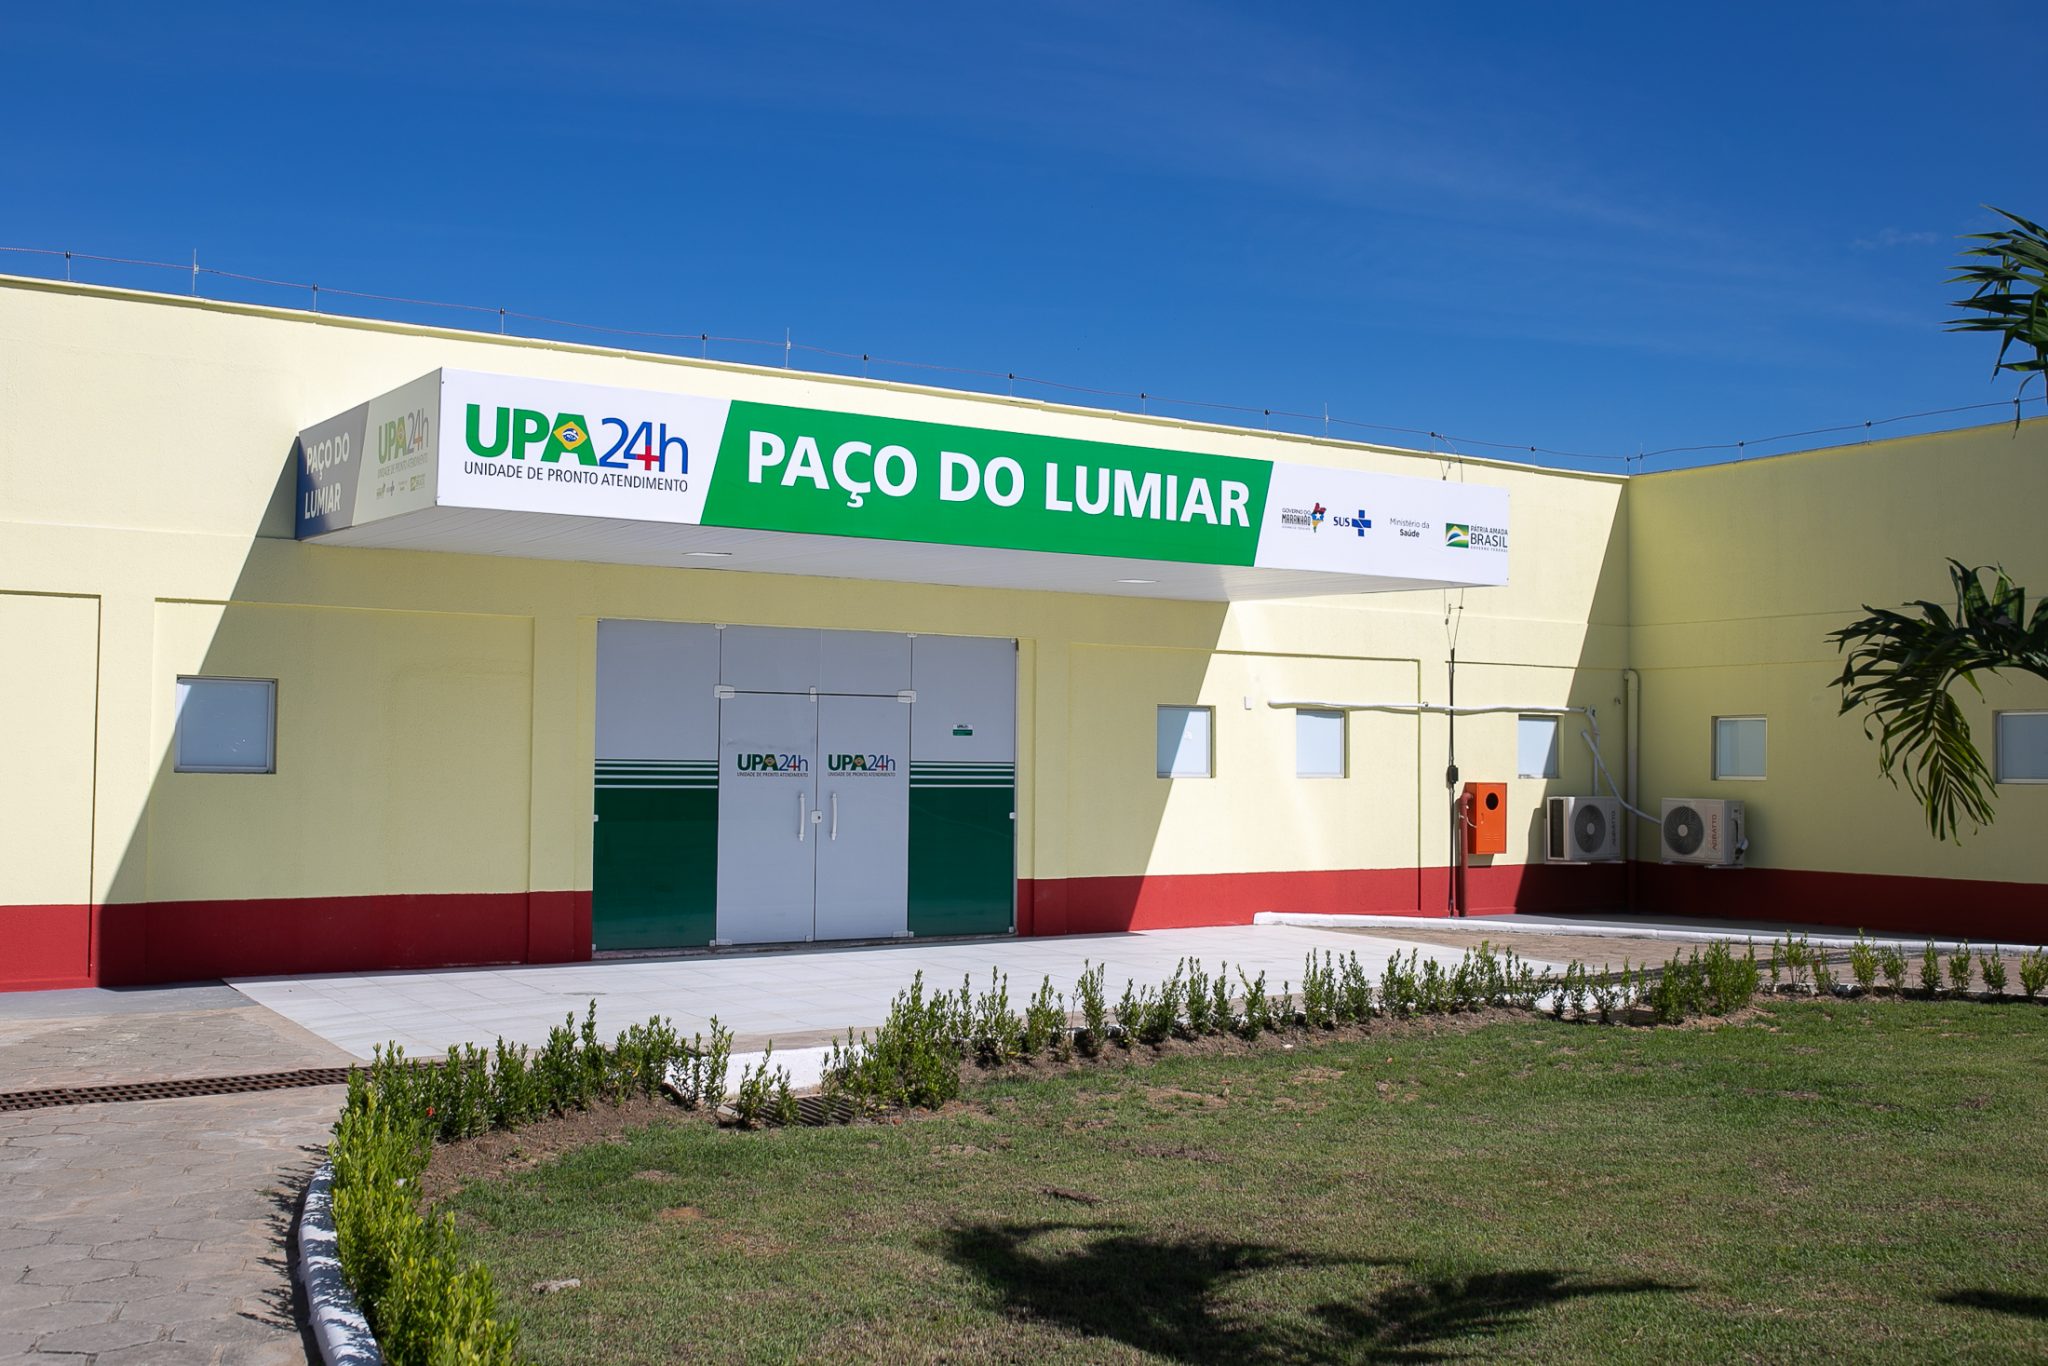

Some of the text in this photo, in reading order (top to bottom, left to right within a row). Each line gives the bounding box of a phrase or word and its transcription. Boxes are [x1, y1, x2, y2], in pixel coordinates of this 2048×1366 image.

[306, 432, 350, 480] PAÇO DO
[464, 461, 688, 492] UNIDADE DE PRONTO ATENDIMENTO
[748, 430, 1251, 528] PAÇO DO LUMIAR
[304, 482, 341, 519] LUMIAR
[1333, 516, 1350, 527] SUS
[1389, 518, 1430, 529] Ministério da
[1399, 529, 1420, 538] Saúde
[1470, 533, 1508, 548] BRASIL
